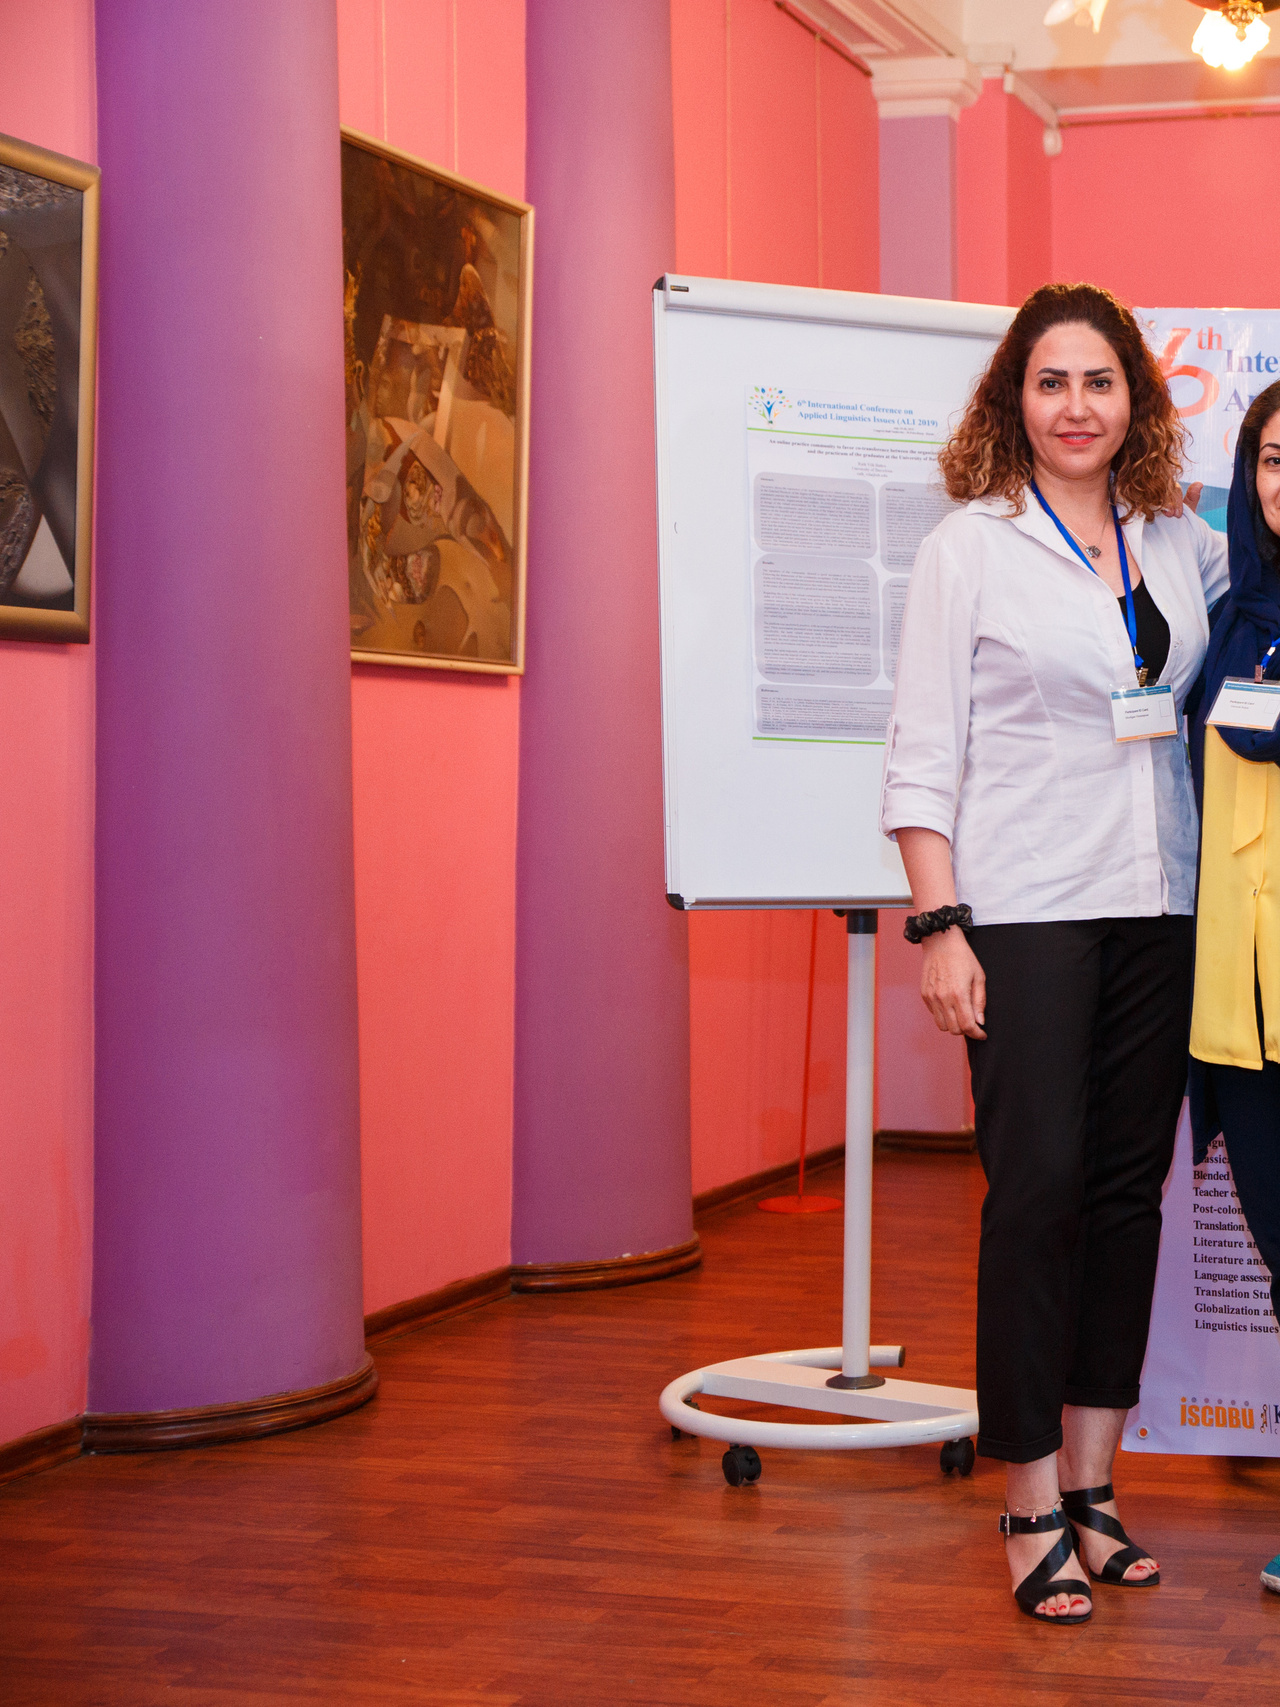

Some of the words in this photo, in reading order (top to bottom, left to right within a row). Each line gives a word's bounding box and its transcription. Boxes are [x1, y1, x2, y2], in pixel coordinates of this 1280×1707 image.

[807, 401, 858, 411] International
[859, 404, 903, 415] Conference
[798, 411, 828, 420] Applied
[829, 413, 872, 422] Linguistics
[873, 416, 895, 424] Issues
[1193, 1170, 1230, 1181] Blended
[1193, 1186, 1229, 1198] Teacher
[1193, 1220, 1245, 1232] Translation
[1193, 1237, 1244, 1249] Literature
[1193, 1253, 1244, 1265] Literature
[1194, 1270, 1239, 1283] Language
[1194, 1286, 1250, 1299] Translation
[1252, 1289, 1270, 1300] Stu
[1194, 1303, 1260, 1316] Globalization
[1195, 1319, 1248, 1332] Linguistics
[1250, 1323, 1279, 1334] issues
